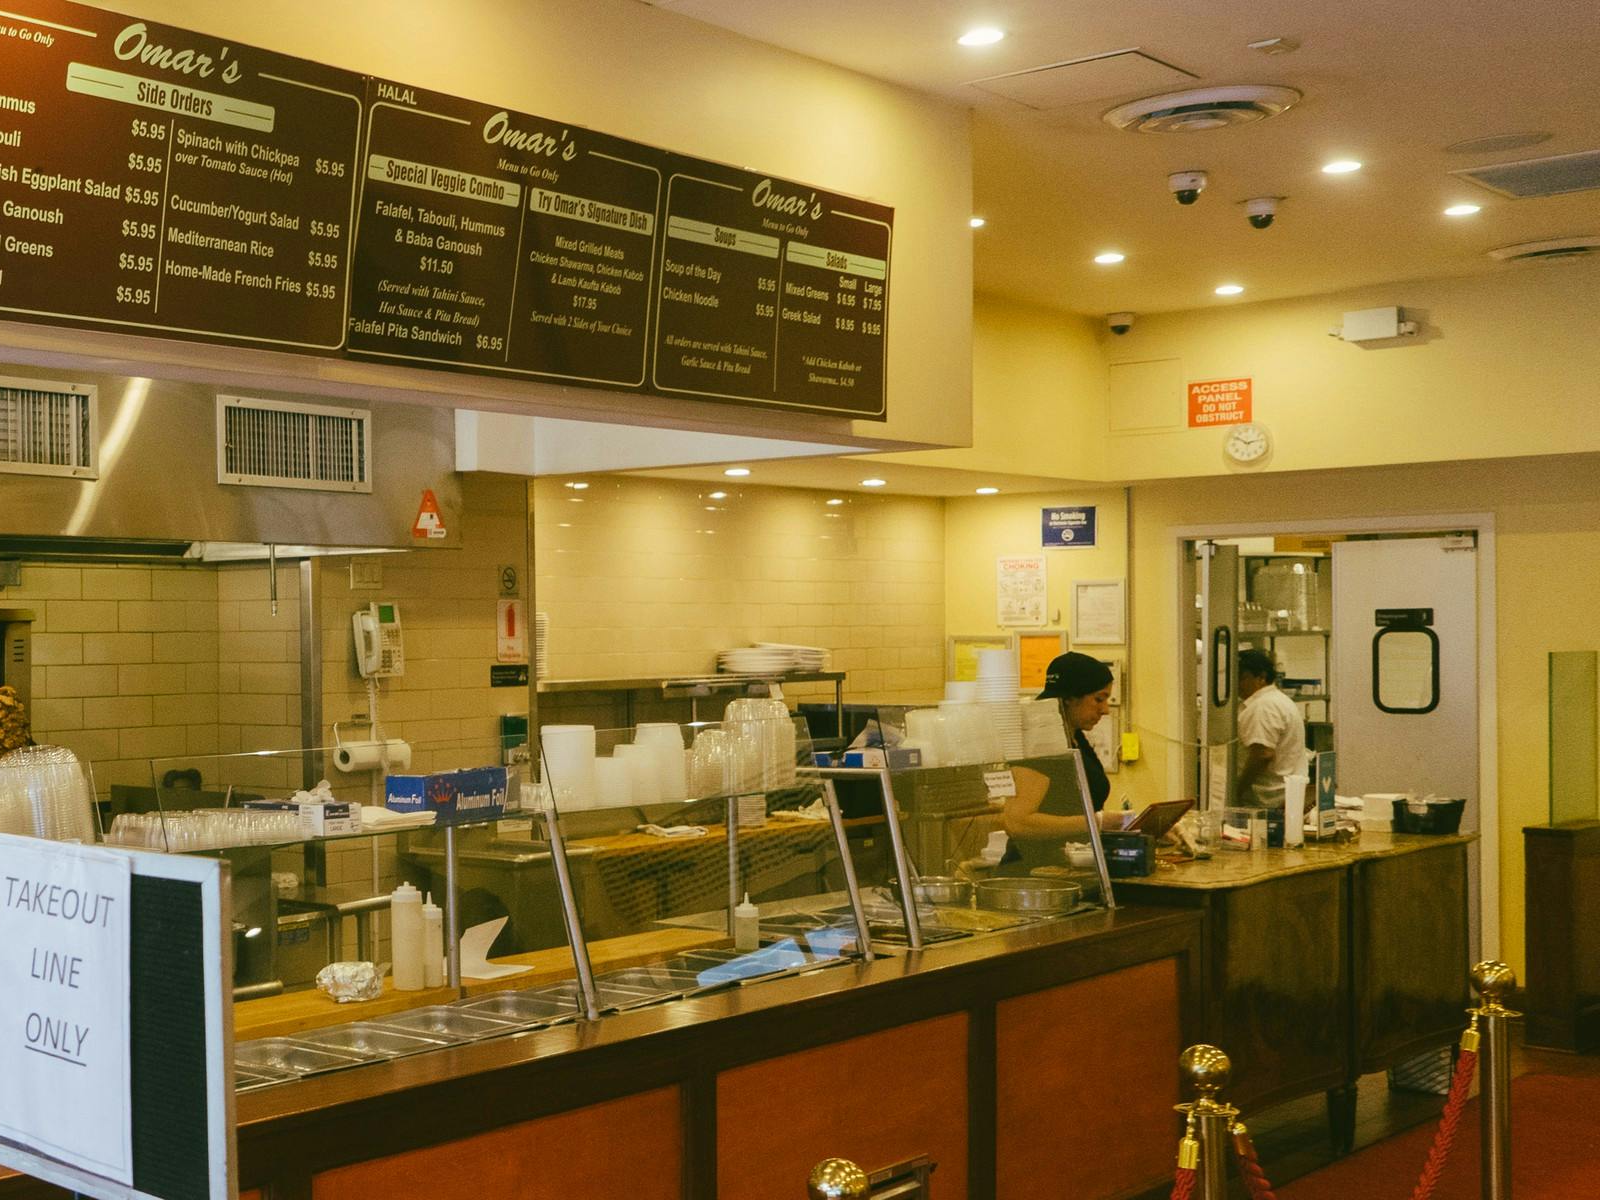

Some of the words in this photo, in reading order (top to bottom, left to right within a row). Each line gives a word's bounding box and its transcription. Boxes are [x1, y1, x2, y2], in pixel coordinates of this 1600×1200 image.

[8, 26, 18, 38] to
[19, 28, 32, 40] Go
[33, 31, 55, 48] Only
[113, 22, 242, 84] Omar's
[137, 81, 166, 106] Side
[170, 89, 213, 116] Orders
[378, 83, 417, 105] HALAL
[131, 119, 165, 140] $5.95
[483, 111, 577, 162] Omar's
[177, 128, 222, 151] Spinach
[225, 140, 248, 157] with
[251, 144, 300, 167] Chickpea
[315, 158, 344, 177] $5.95
[21, 167, 81, 193] Eggplant
[84, 179, 121, 199] Salad
[175, 152, 199, 165] over
[201, 154, 237, 173] Tomato
[238, 162, 268, 179] Sauce
[270, 168, 293, 186] (Hot)
[386, 160, 428, 185] Special
[431, 169, 466, 193] Veggie
[469, 177, 504, 200] Combo
[496, 158, 519, 173] Menu
[520, 165, 528, 174] to
[529, 165, 541, 177] Go
[541, 168, 559, 184] Only
[3, 200, 63, 224] Ganoush
[171, 194, 267, 226] Cucumber/Yogurt
[269, 211, 299, 230] Salad
[538, 191, 552, 212] Try
[554, 195, 586, 217] Omar's
[587, 202, 627, 226] Signature
[629, 211, 647, 231] Dish
[752, 178, 823, 221] Omar's
[375, 200, 414, 221] Falafel,
[417, 208, 458, 231] Tabouli,
[460, 216, 505, 237] Hummus
[5, 236, 53, 257] Greens
[168, 227, 247, 253] Mediterranean
[250, 240, 274, 257] Rice
[395, 228, 403, 242] &
[406, 230, 433, 248] Baba
[436, 236, 482, 256] Ganoush
[554, 235, 578, 251] Mixed
[578, 240, 601, 255] Grilled
[604, 245, 624, 260] Meats
[165, 259, 232, 283] Home-Made
[234, 270, 272, 289] French
[275, 276, 301, 293] Fries
[420, 256, 453, 274] $11.50
[665, 259, 684, 275] Soup
[685, 264, 694, 275] of
[695, 265, 706, 278] the
[707, 267, 722, 284] Day
[663, 287, 693, 304] Chicken
[694, 293, 719, 308] Noodle
[349, 317, 385, 336] Falafel
[387, 323, 408, 338] Pita
[411, 326, 462, 346] Sandwich
[476, 334, 503, 350] $6.95
[1192, 381, 1248, 394] ACCESS
[1197, 392, 1242, 404] PANEL
[1196, 411, 1245, 423] OBSTRUCT
[1202, 403, 1216, 413] DO
[1218, 401, 1237, 411] NOT
[1051, 512, 1060, 521] No
[1060, 511, 1086, 521] Smoking
[456, 790, 490, 812] Aluminum
[492, 788, 505, 807] Foil
[5, 876, 115, 928] TAKEOUT
[31, 948, 83, 989] LINE
[26, 1012, 89, 1057] ONLY
